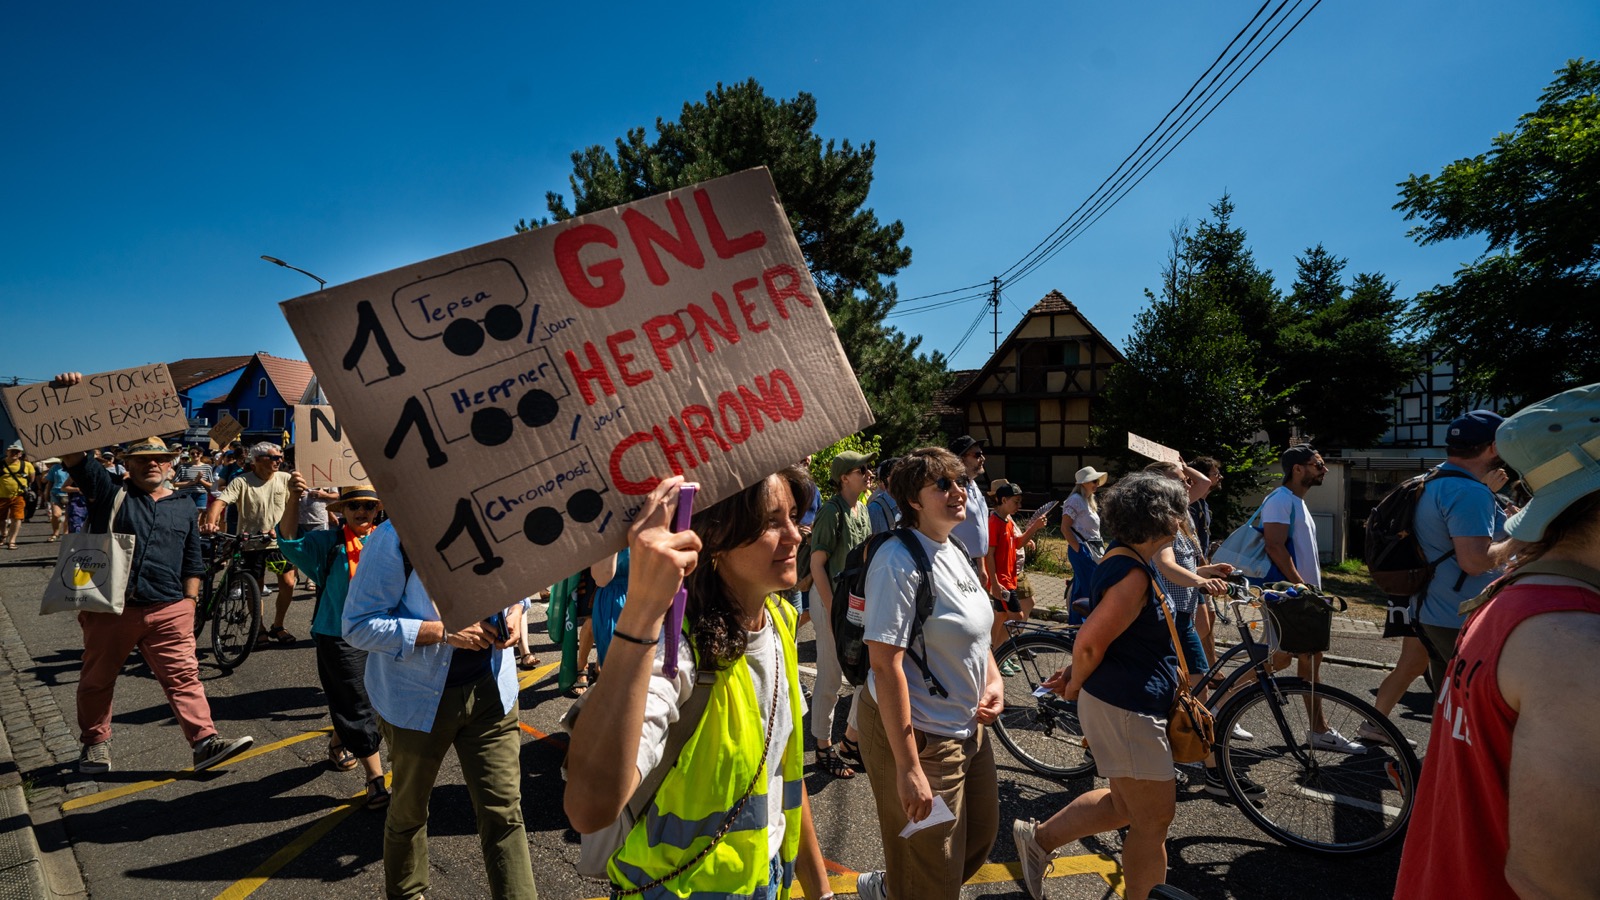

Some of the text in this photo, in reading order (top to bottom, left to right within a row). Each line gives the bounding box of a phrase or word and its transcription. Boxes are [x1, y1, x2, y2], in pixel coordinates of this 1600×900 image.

[554, 188, 767, 309] GNL
[411, 289, 492, 324] Tepsa
[564, 263, 814, 406] HEPPNER
[17, 363, 166, 414] GAZ STOCKÉ
[450, 362, 550, 414] Heppner
[19, 392, 180, 447] VOISINS EXPOSÉS
[609, 368, 804, 496] CHRONO
[485, 460, 591, 522] Chronopost
